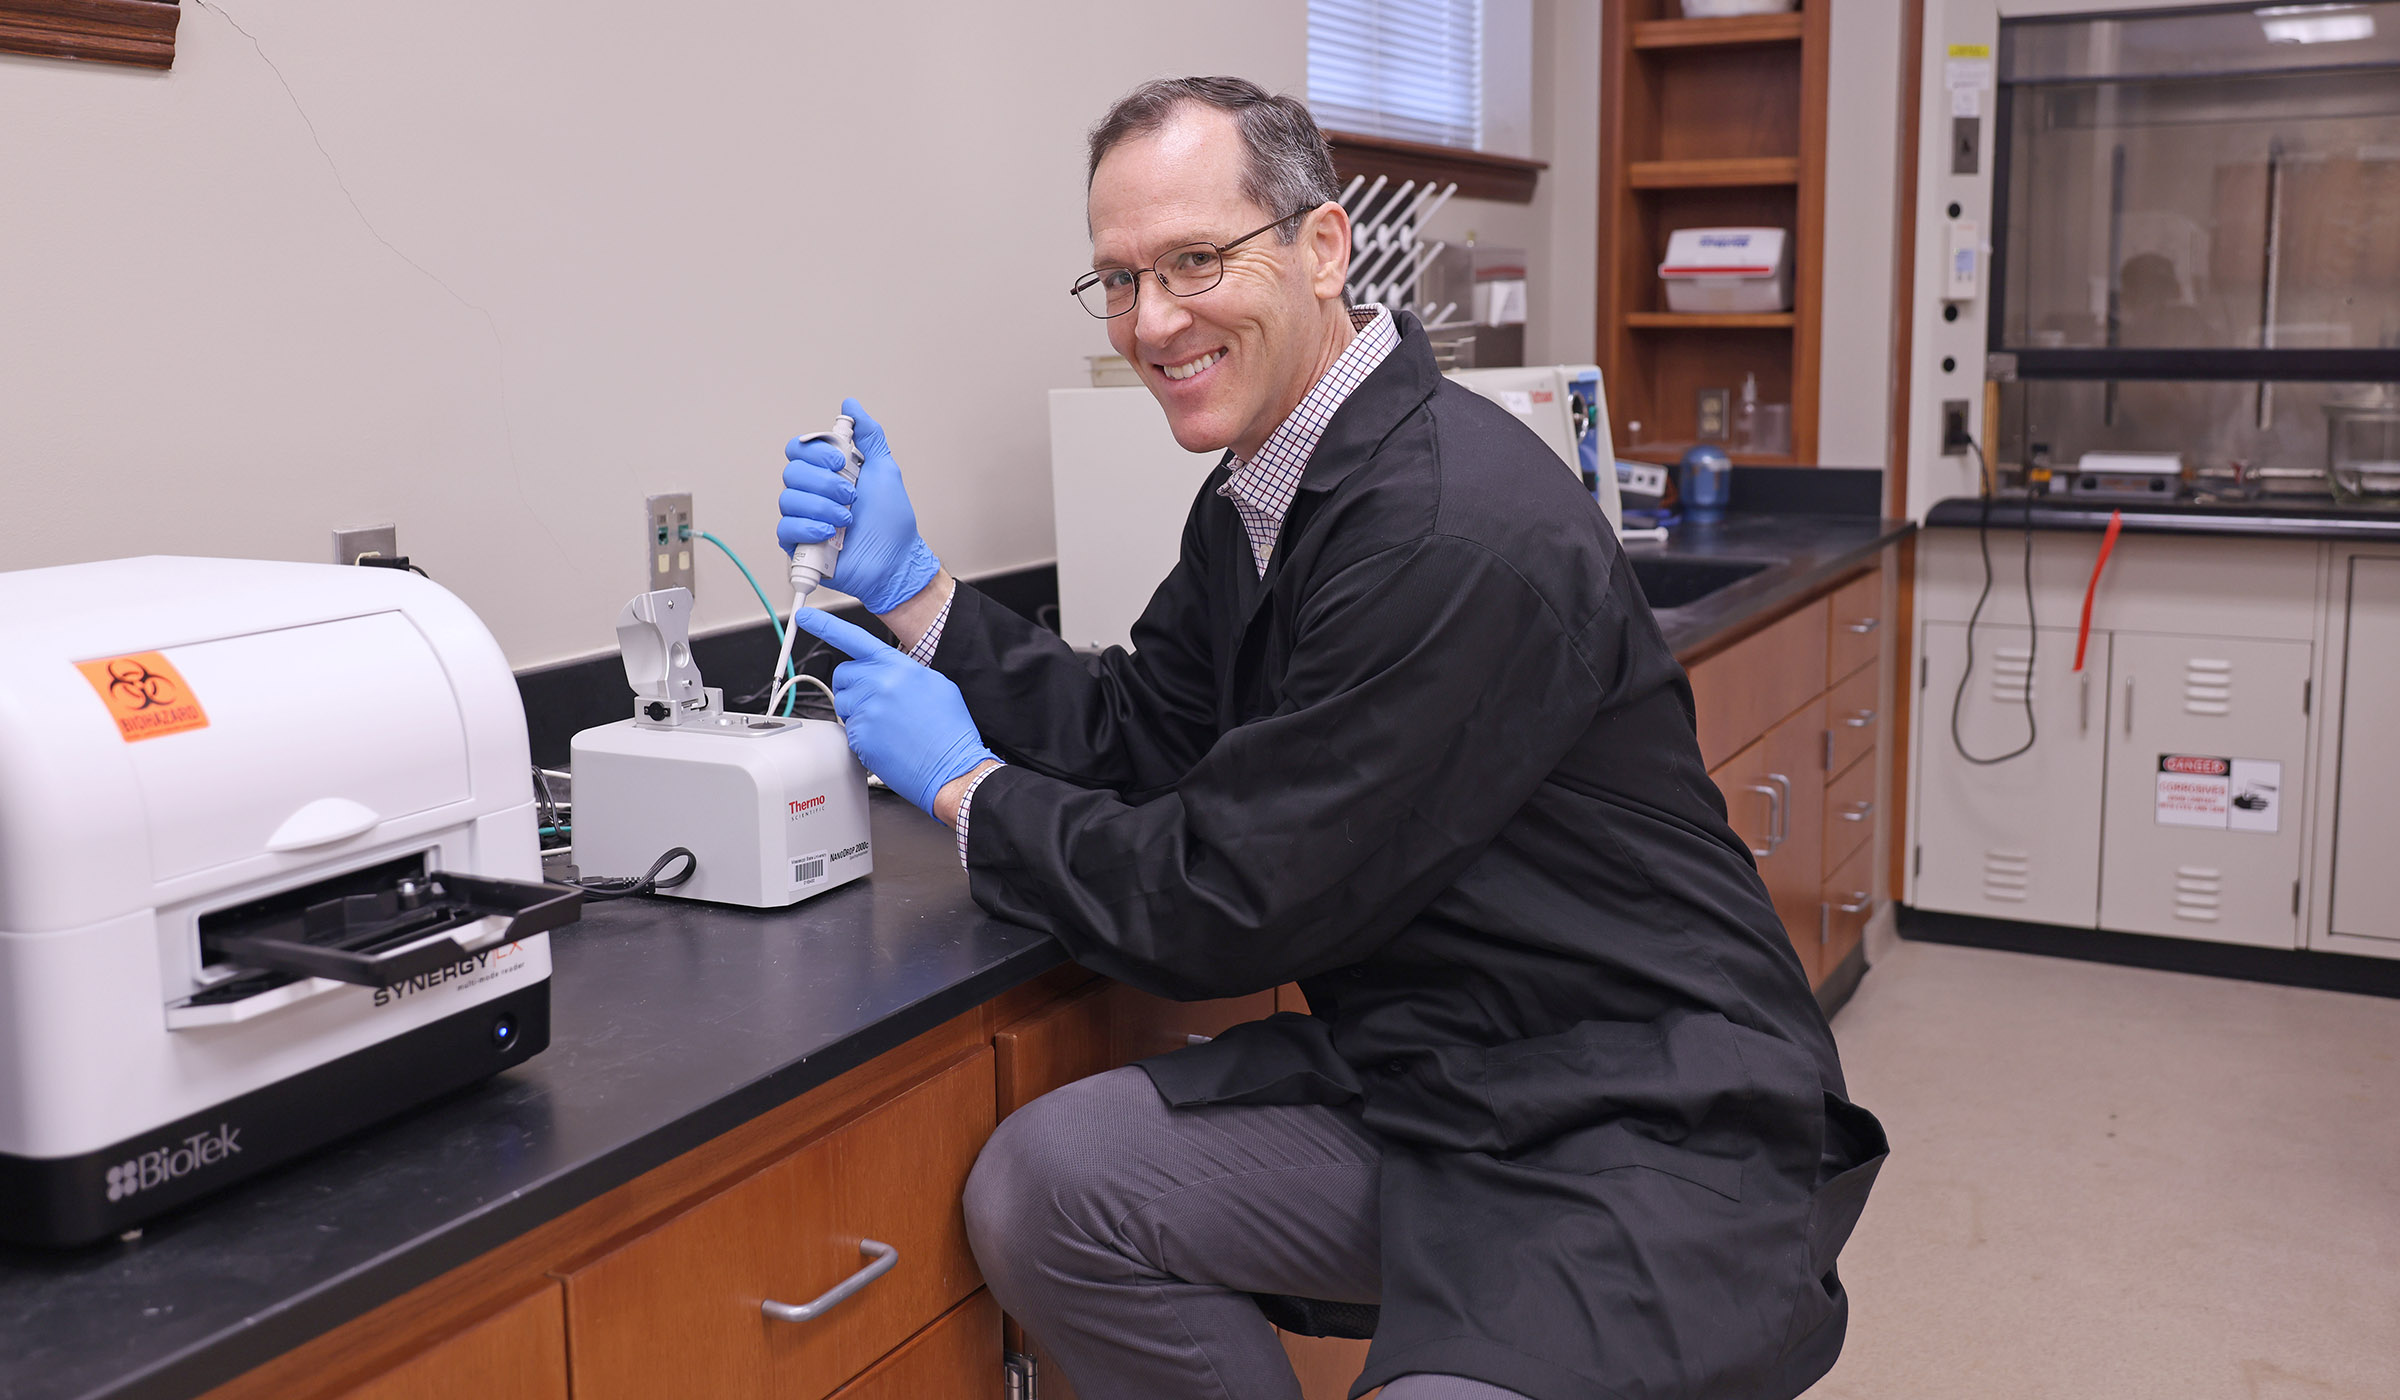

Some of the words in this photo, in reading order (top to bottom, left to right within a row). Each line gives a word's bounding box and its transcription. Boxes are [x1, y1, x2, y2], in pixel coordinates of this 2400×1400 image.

[121, 705, 199, 732] BIOHAZARD
[2166, 758, 2225, 774] DANGER
[789, 795, 825, 814] Thermo
[791, 806, 825, 821] SCIENTIFIC
[374, 951, 489, 1007] SYNERGY
[457, 971, 499, 991] multi-mode
[501, 962, 525, 975] reader
[138, 1123, 242, 1190] BioTek
